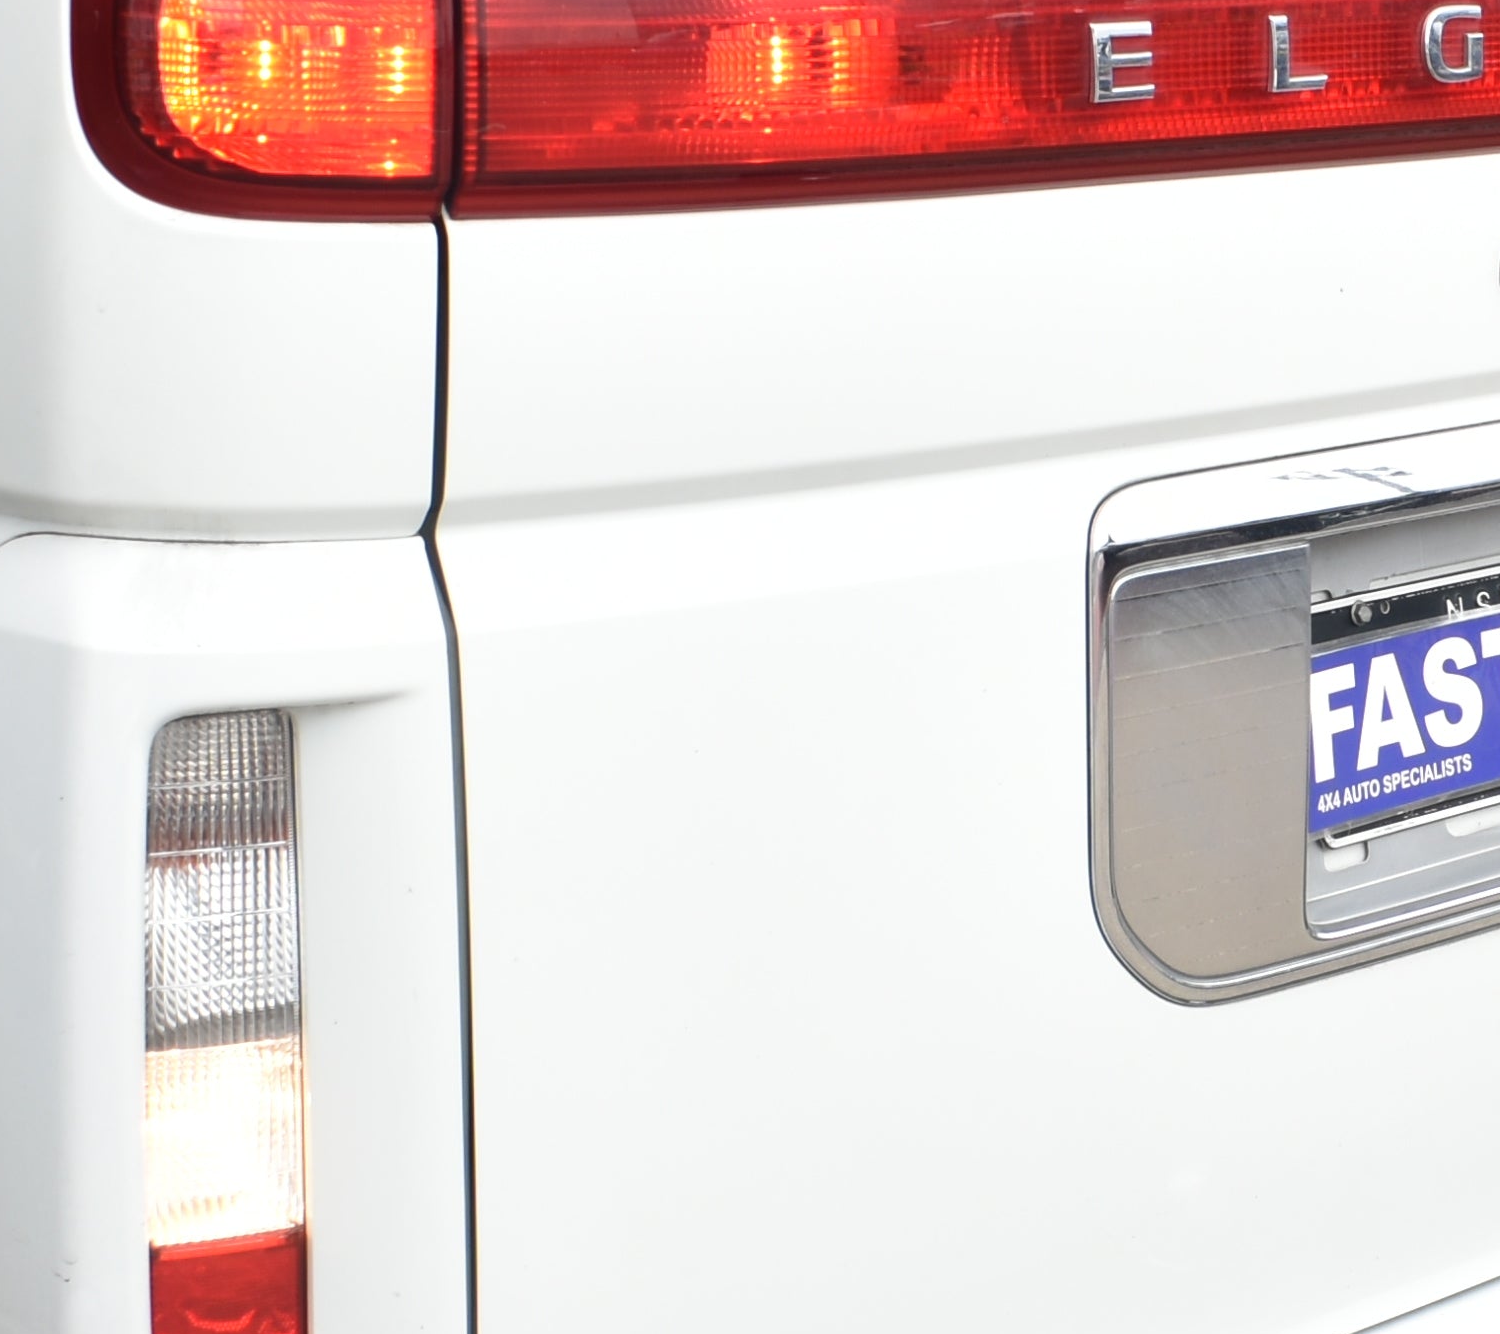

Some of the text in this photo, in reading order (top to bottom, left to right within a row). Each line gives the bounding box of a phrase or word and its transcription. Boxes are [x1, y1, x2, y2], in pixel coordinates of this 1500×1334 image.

[1317, 753, 1473, 814] 4X4 AUTO SPECIALISTS
